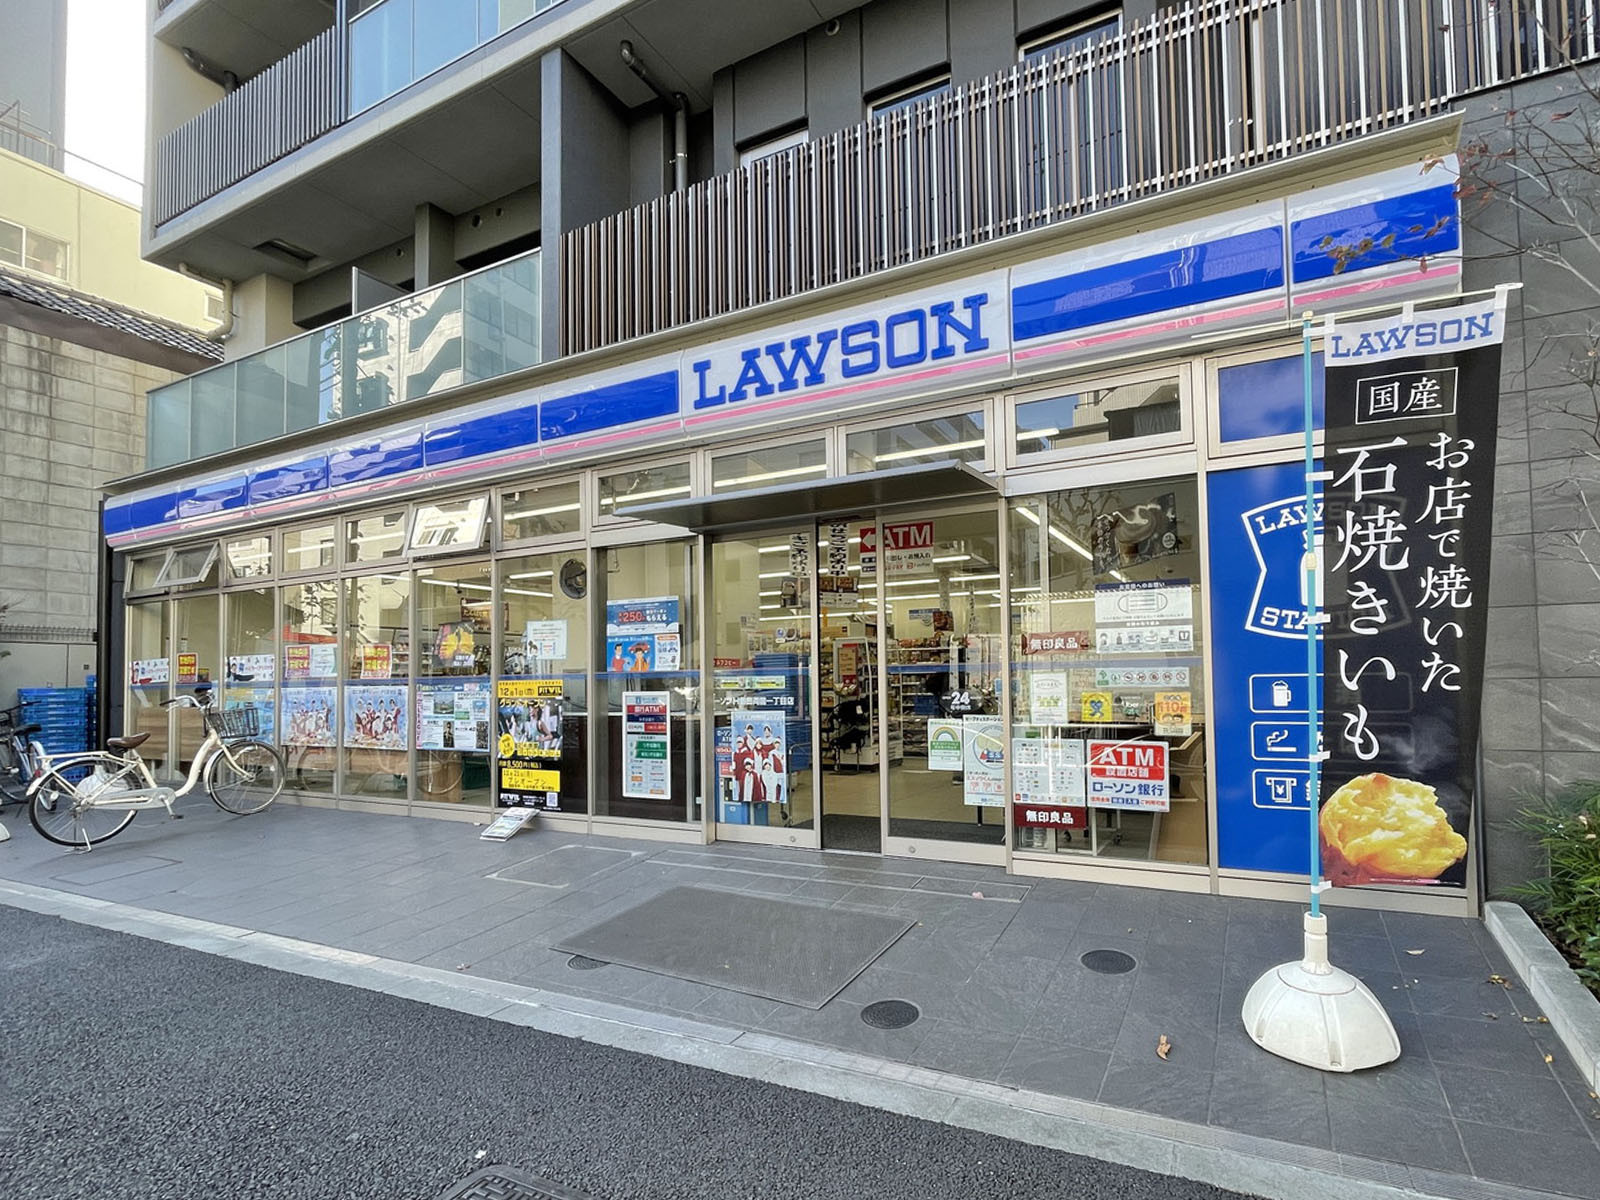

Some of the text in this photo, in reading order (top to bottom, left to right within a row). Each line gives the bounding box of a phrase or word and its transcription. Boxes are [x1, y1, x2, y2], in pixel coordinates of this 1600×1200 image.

[1331, 311, 1494, 358] LAWSON
[693, 292, 989, 410] LAWSON
[1368, 376, 1442, 416] 国産
[884, 524, 931, 549] ATM
[1415, 432, 1475, 692] お店で焼いた
[1332, 436, 1409, 760] 石焼きいも
[1030, 637, 1078, 650] 無印良品
[951, 691, 970, 705] 24
[1099, 747, 1154, 767] ATM
[1092, 782, 1164, 797] ローソン銀行
[1026, 810, 1074, 824] 無印良品
